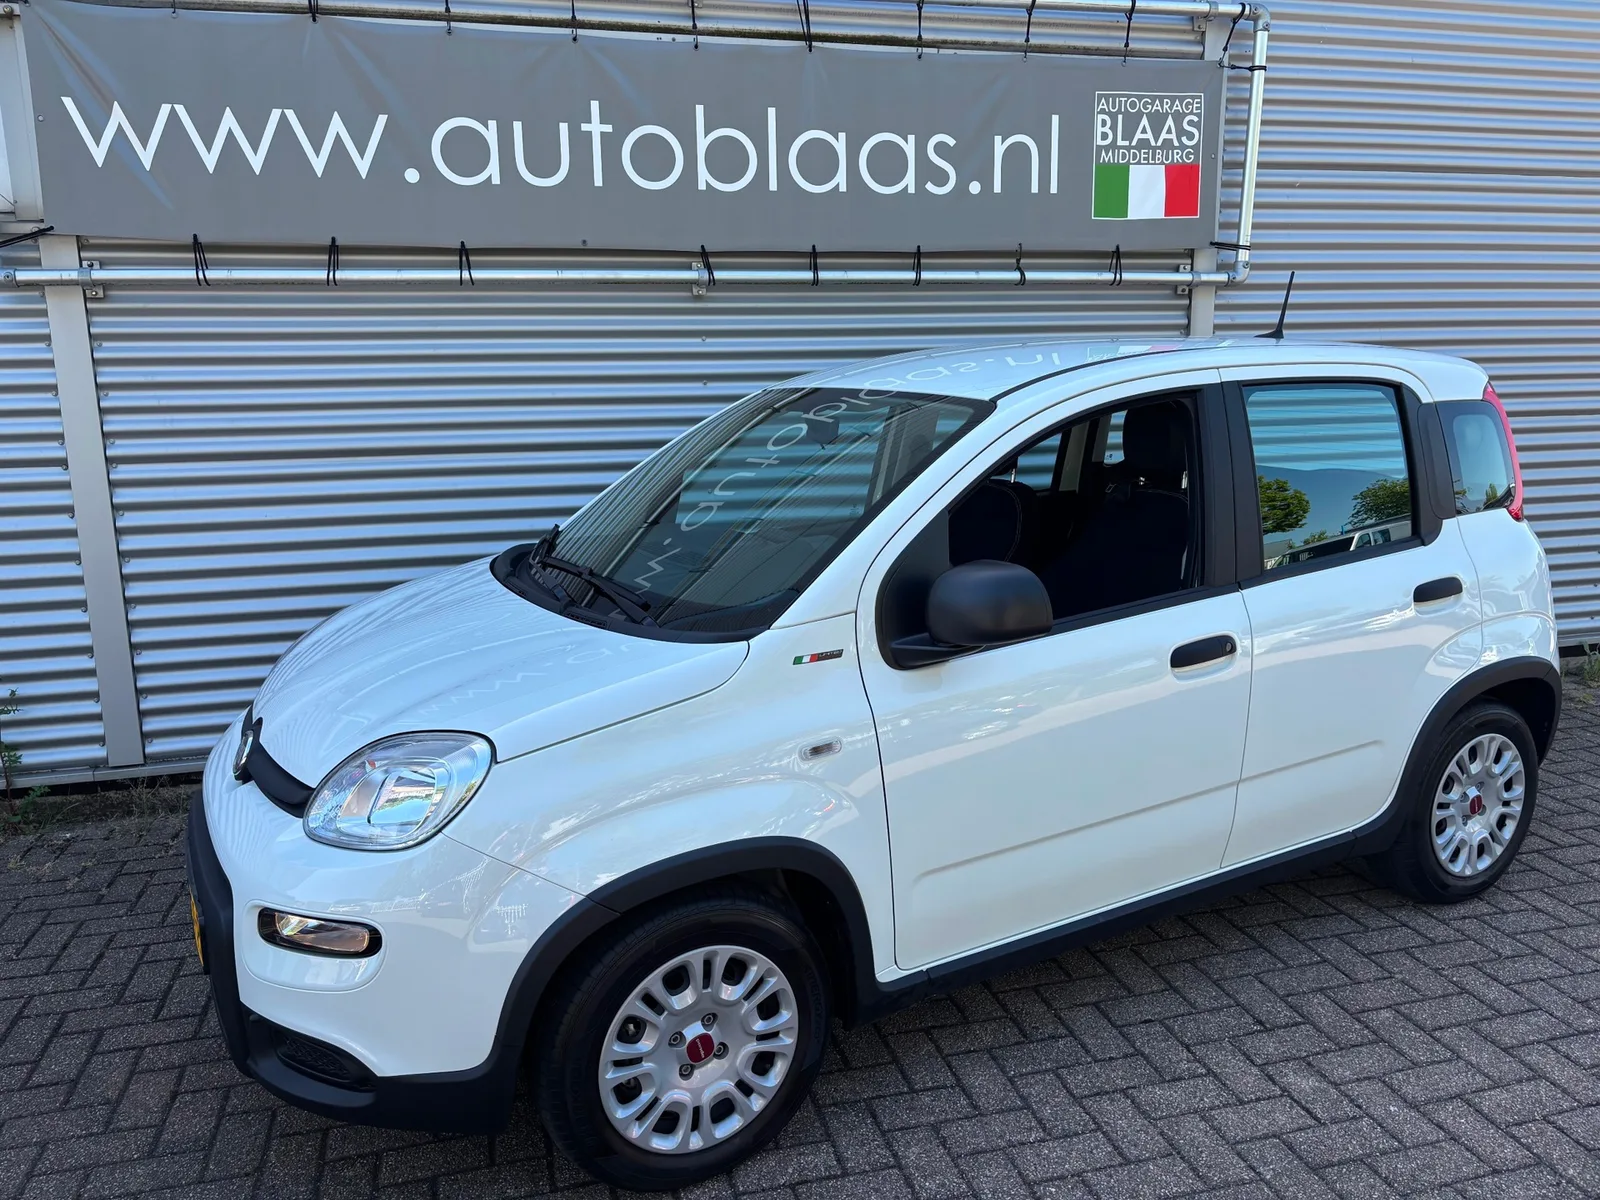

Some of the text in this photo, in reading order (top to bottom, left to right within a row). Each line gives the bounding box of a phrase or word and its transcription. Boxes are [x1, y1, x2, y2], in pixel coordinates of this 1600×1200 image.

[1097, 97, 1201, 113] AUTOGARAGE
[1096, 113, 1200, 146] BLAAS
[60, 96, 1060, 196] www.autoblaas.nl
[1099, 148, 1195, 164] MIDDELBURG
